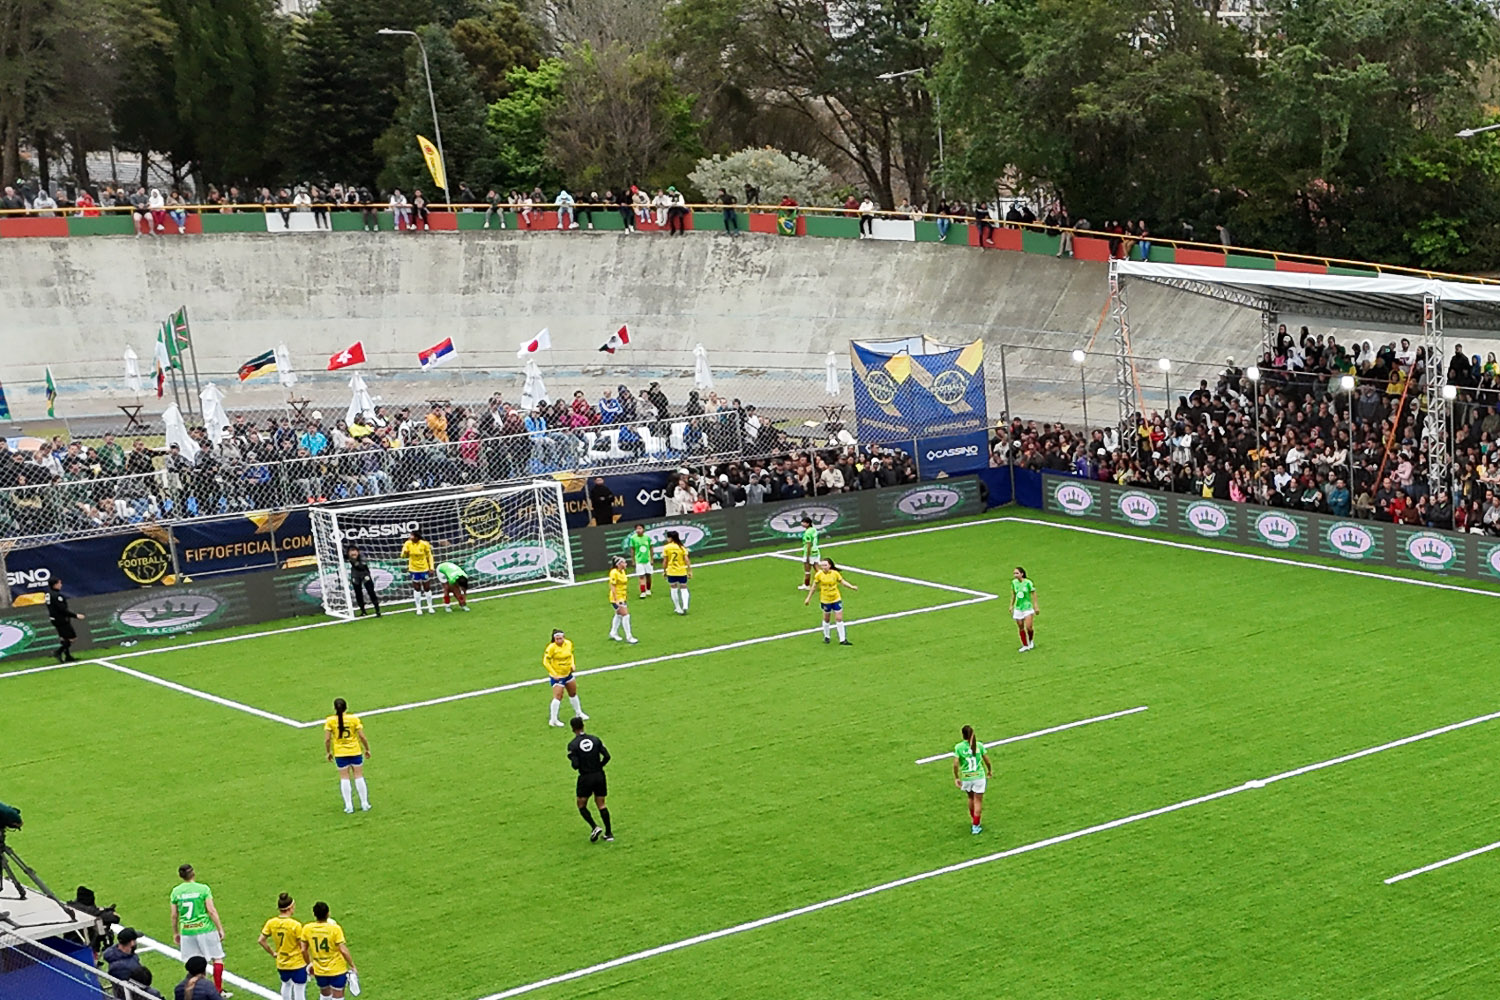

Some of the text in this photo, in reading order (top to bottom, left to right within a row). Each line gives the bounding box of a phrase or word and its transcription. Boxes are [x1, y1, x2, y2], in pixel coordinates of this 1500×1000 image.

[937, 445, 979, 458] CASSINO
[345, 520, 419, 540] CASSINO
[185, 534, 313, 562] FIF7OFFICIAL.COM
[118, 556, 165, 568] FOOTBALL
[182, 900, 194, 920] 7
[277, 931, 285, 947] 7
[312, 936, 330, 953] 14
